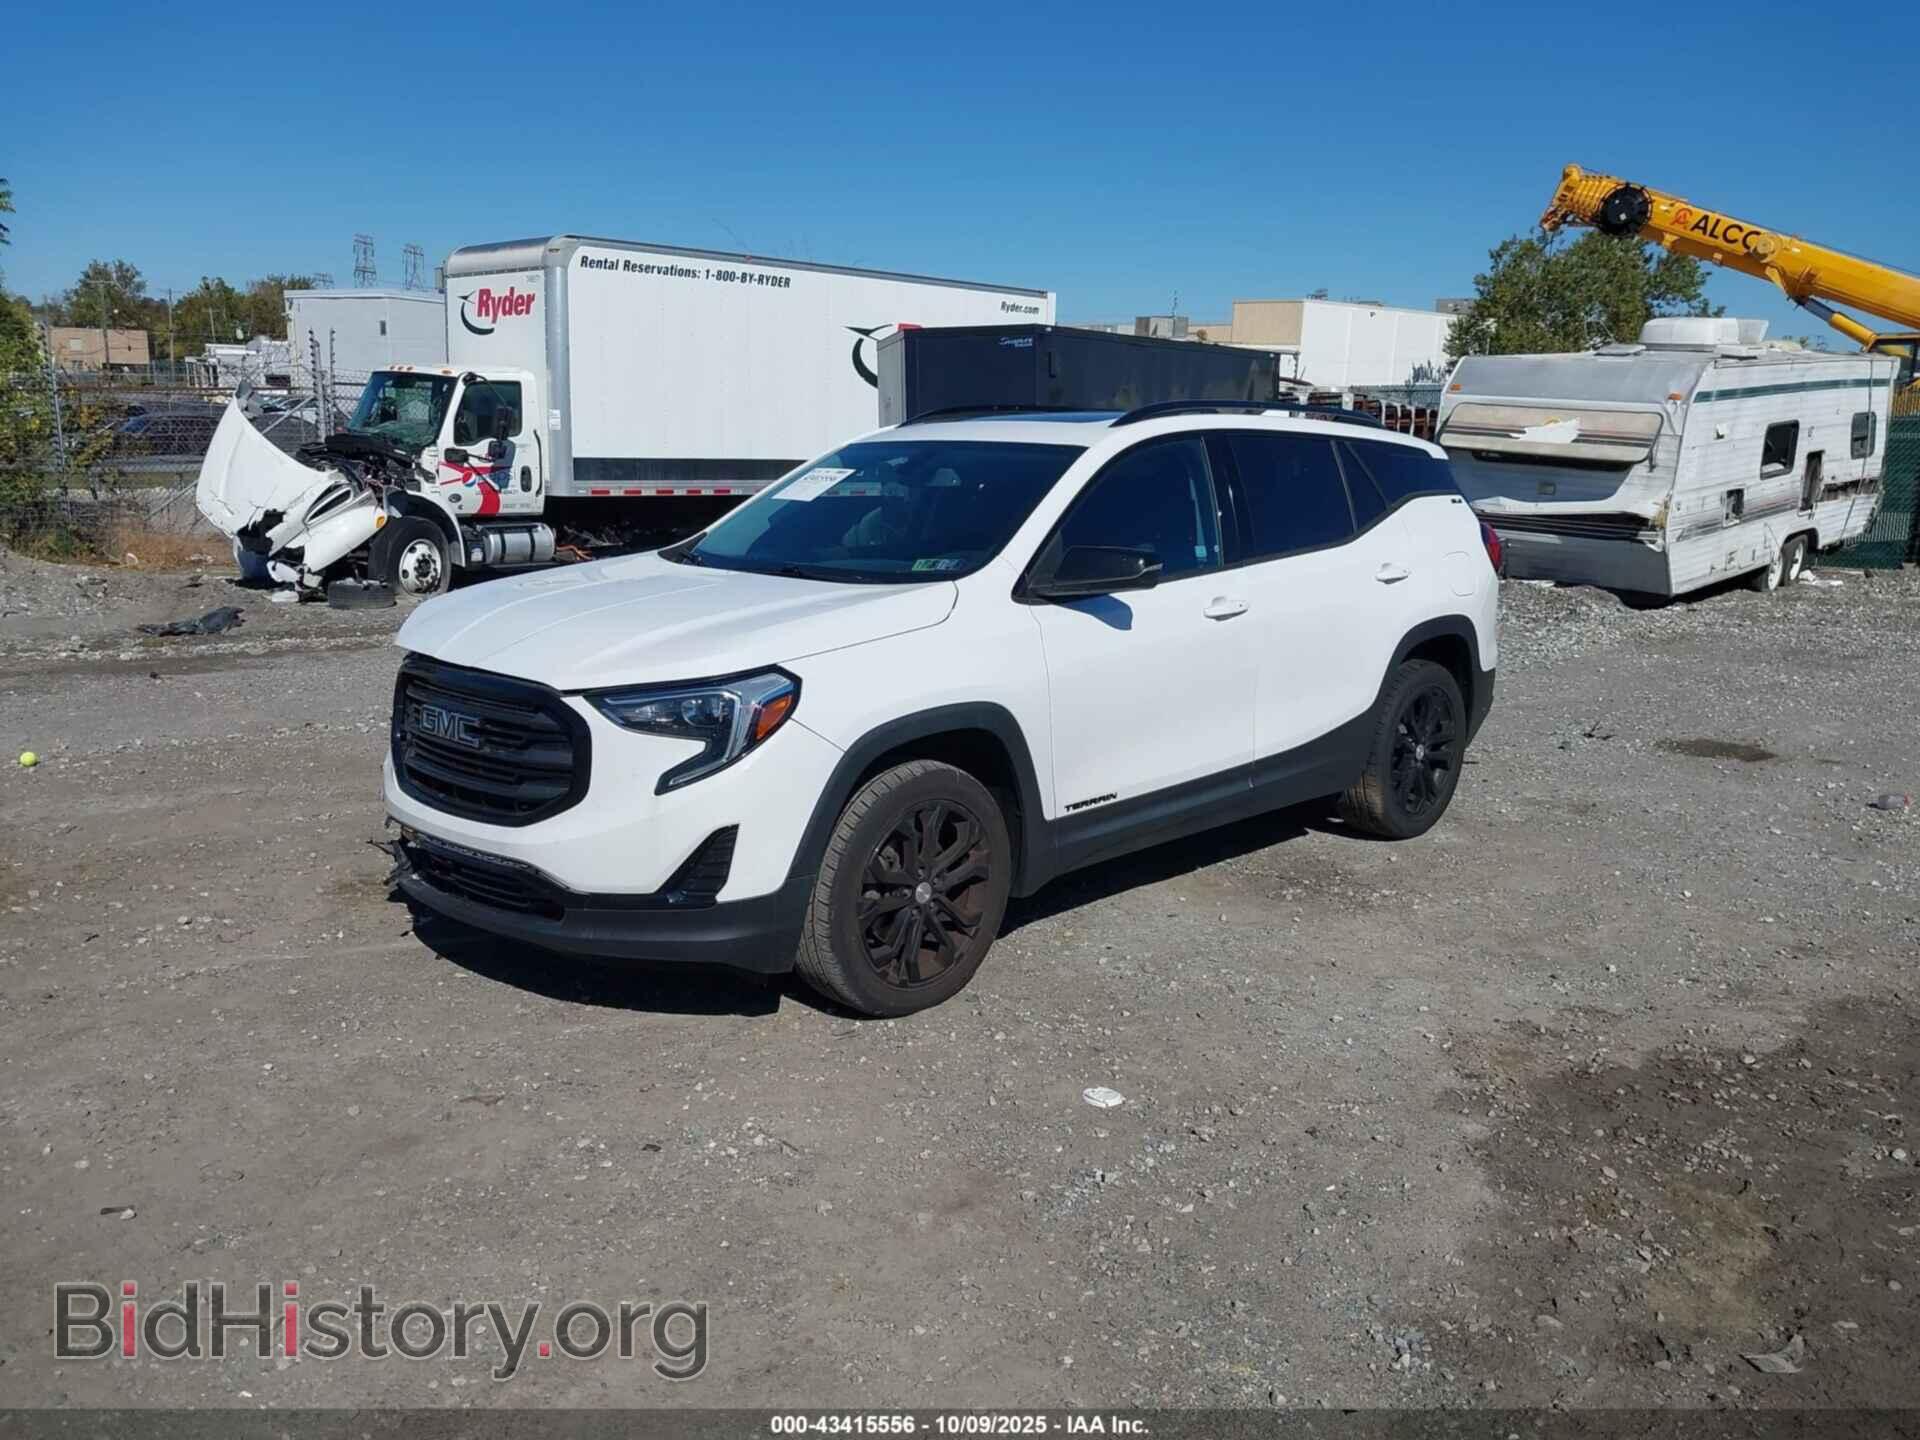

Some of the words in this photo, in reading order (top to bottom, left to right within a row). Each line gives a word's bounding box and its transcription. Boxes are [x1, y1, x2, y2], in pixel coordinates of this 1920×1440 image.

[580, 255, 619, 271] Rental
[623, 259, 701, 280] Reservations:
[704, 268, 791, 288] 1-800-BY-RYDER
[477, 286, 536, 324] Ryder
[1000, 300, 1040, 315] Ryder.com
[419, 703, 480, 749] GMC
[1064, 792, 1118, 813] TERRAIN
